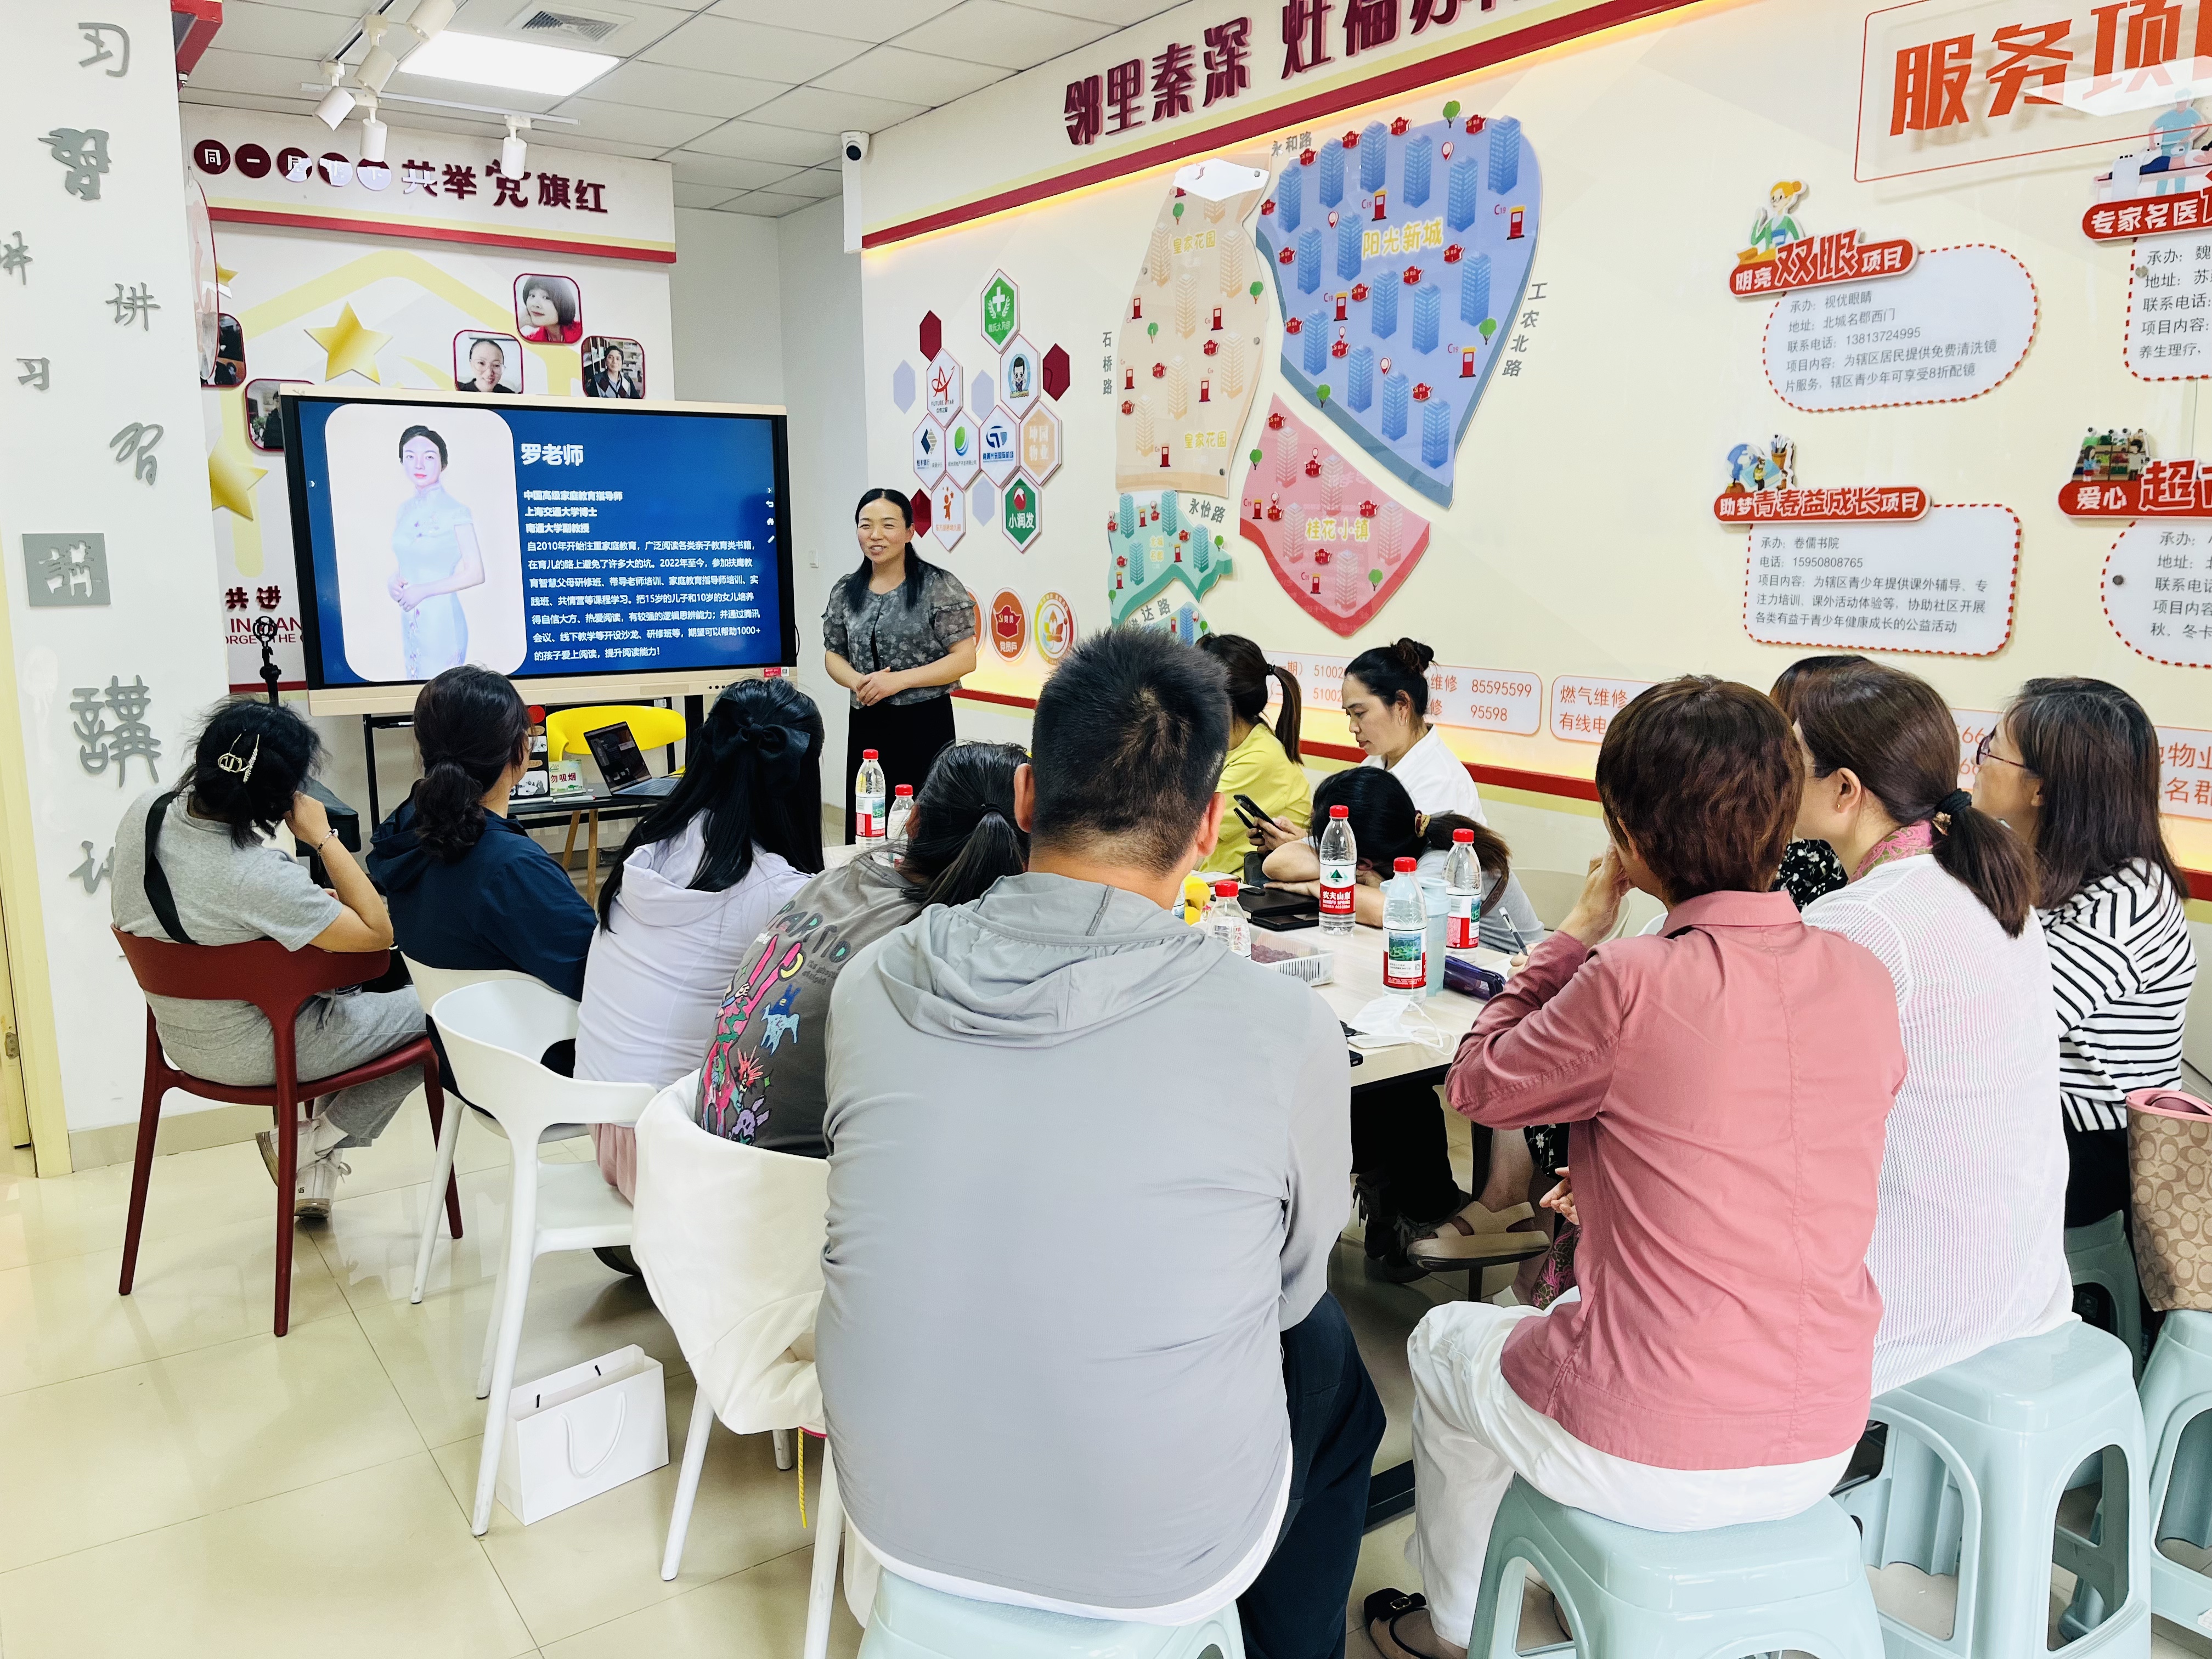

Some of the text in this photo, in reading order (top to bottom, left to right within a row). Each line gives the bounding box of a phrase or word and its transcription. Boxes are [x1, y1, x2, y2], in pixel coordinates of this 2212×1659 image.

[1890, 0, 2212, 136] 服务项
[1271, 131, 1312, 156] 永和路
[1494, 204, 1506, 215] C19
[2091, 193, 2212, 234] 专家名医
[1172, 229, 1216, 255] 皇家花园
[1362, 219, 1444, 258] 阳光新城
[1735, 228, 1903, 291] 明亮双眼项目
[2145, 269, 2212, 289] 地址：苏
[105, 281, 161, 332] 讲
[1502, 282, 1548, 377] 工农北路
[1448, 343, 1459, 353] C19
[16, 357, 50, 391] 习
[1102, 331, 1113, 395] 石桥路
[1184, 431, 1227, 449] 皇家花园
[521, 443, 584, 466] 罗老师
[523, 490, 623, 501] 中国高级家庭教育指导师
[1719, 487, 1920, 517] 助梦青春益成长项目
[524, 506, 597, 517] 上海交通大学博士
[1008, 512, 1035, 529] 小润发
[1189, 498, 1226, 523] 永怡路
[526, 523, 590, 534] 南通大学副教授
[1306, 518, 1369, 541] 桂花小镇
[2160, 531, 2212, 546] 承办：
[230, 618, 251, 633] IN
[1314, 664, 1347, 679] 51002
[1427, 673, 1532, 698] 维修 85595599
[1560, 685, 1628, 709] 燃气维修
[1470, 704, 1508, 722] 95598
[2159, 742, 2212, 769] 物业
